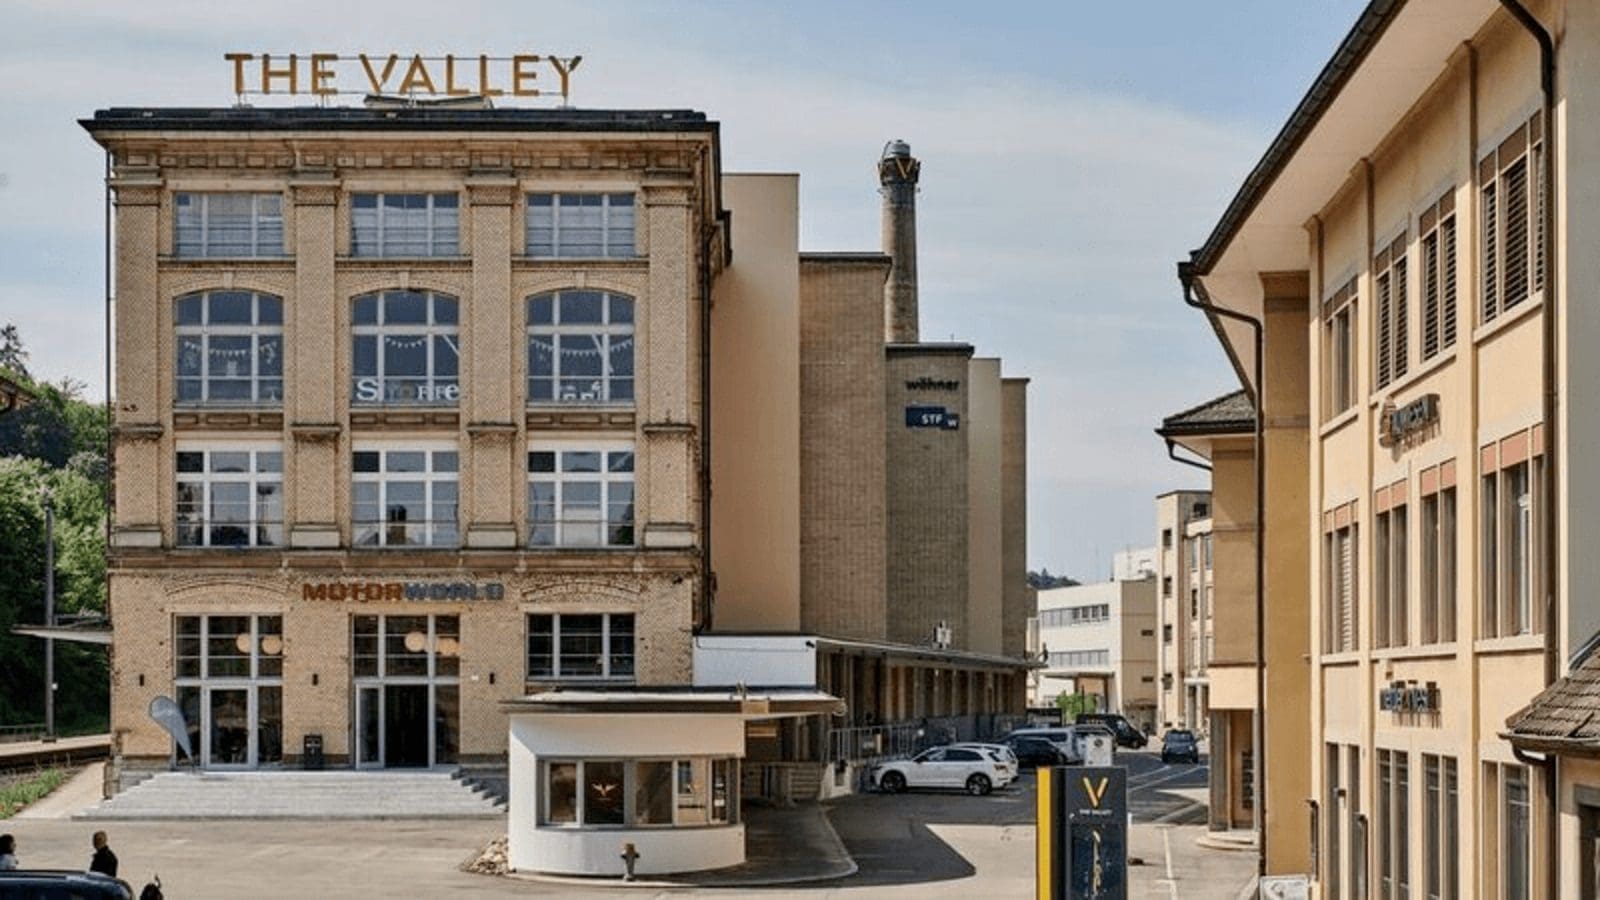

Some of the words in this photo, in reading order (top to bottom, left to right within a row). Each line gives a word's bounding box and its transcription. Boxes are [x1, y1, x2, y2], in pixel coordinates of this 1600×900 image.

[225, 53, 338, 95] THE
[358, 53, 582, 97] VALLEY
[921, 414, 943, 425] STF
